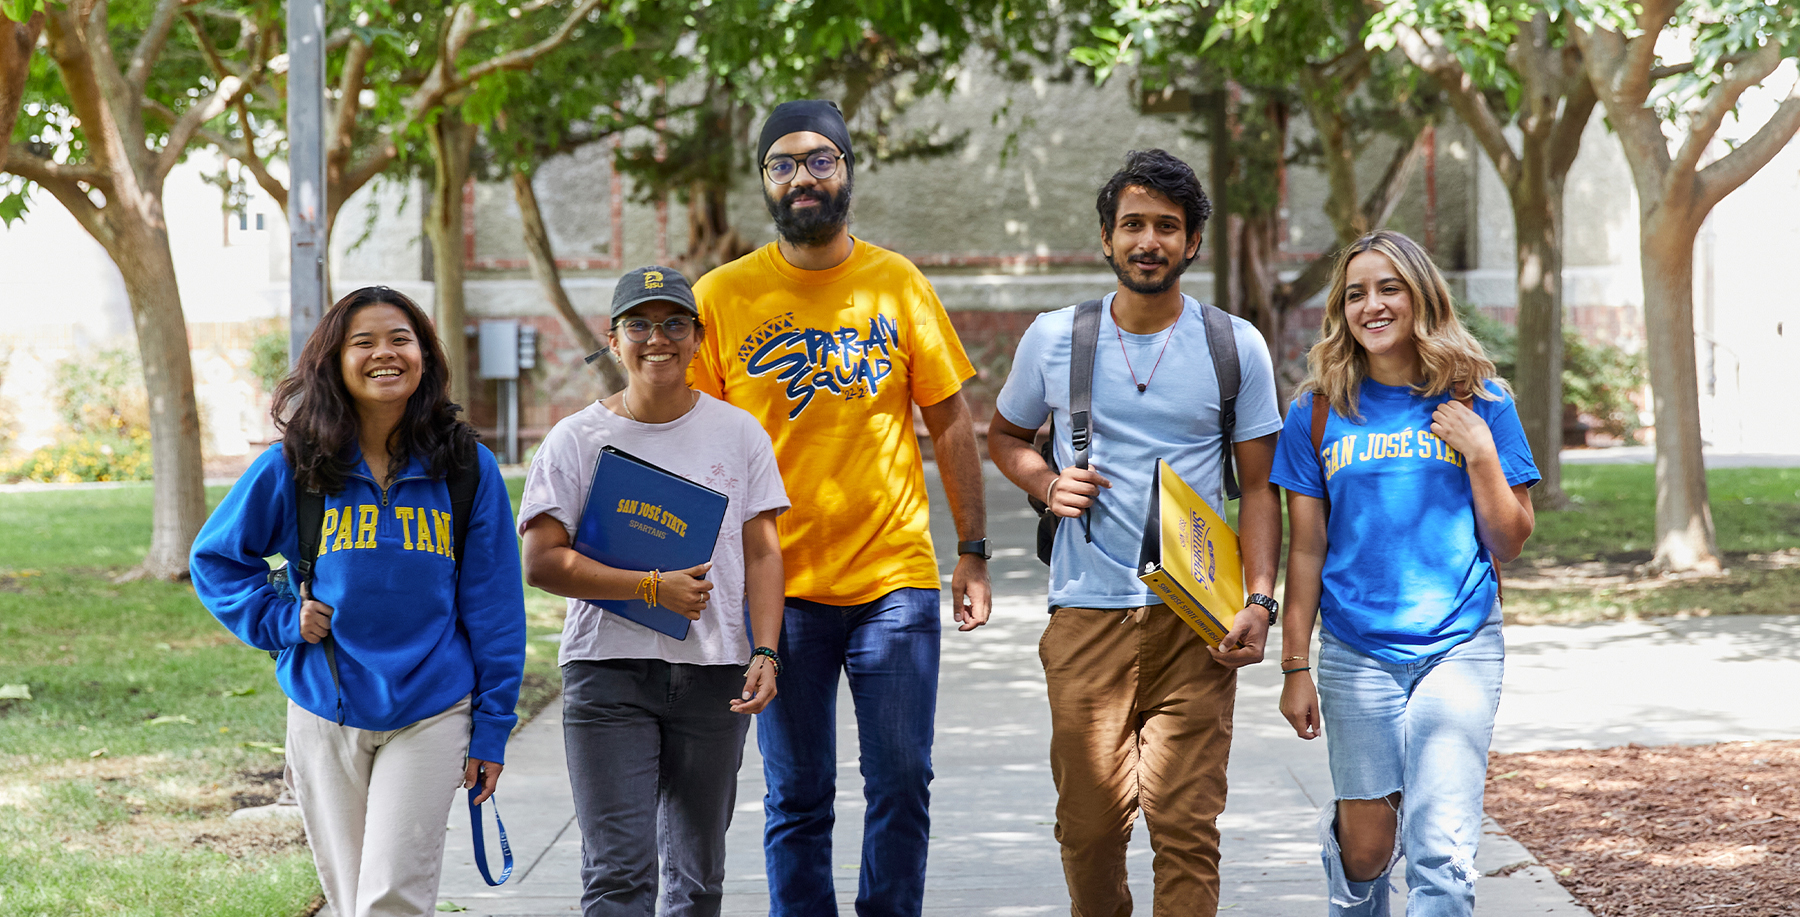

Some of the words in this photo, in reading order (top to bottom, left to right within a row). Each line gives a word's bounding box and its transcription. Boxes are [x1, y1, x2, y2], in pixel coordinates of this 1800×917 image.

[644, 281, 664, 290] SJSU
[746, 313, 899, 383] SPARTAN
[786, 358, 892, 421] SQUAD
[1322, 435, 1357, 481] SAN
[1359, 427, 1413, 461] JOSÉ
[616, 498, 639, 515] SAN
[637, 502, 662, 522] JOSÉ
[660, 510, 688, 538] STATE
[628, 519, 667, 540] SPARTANS
[1192, 510, 1209, 591] SPARTANS
[1157, 582, 1172, 594] SAN
[1180, 604, 1199, 620] STATE
[1194, 618, 1222, 646] UNIVERSIT
